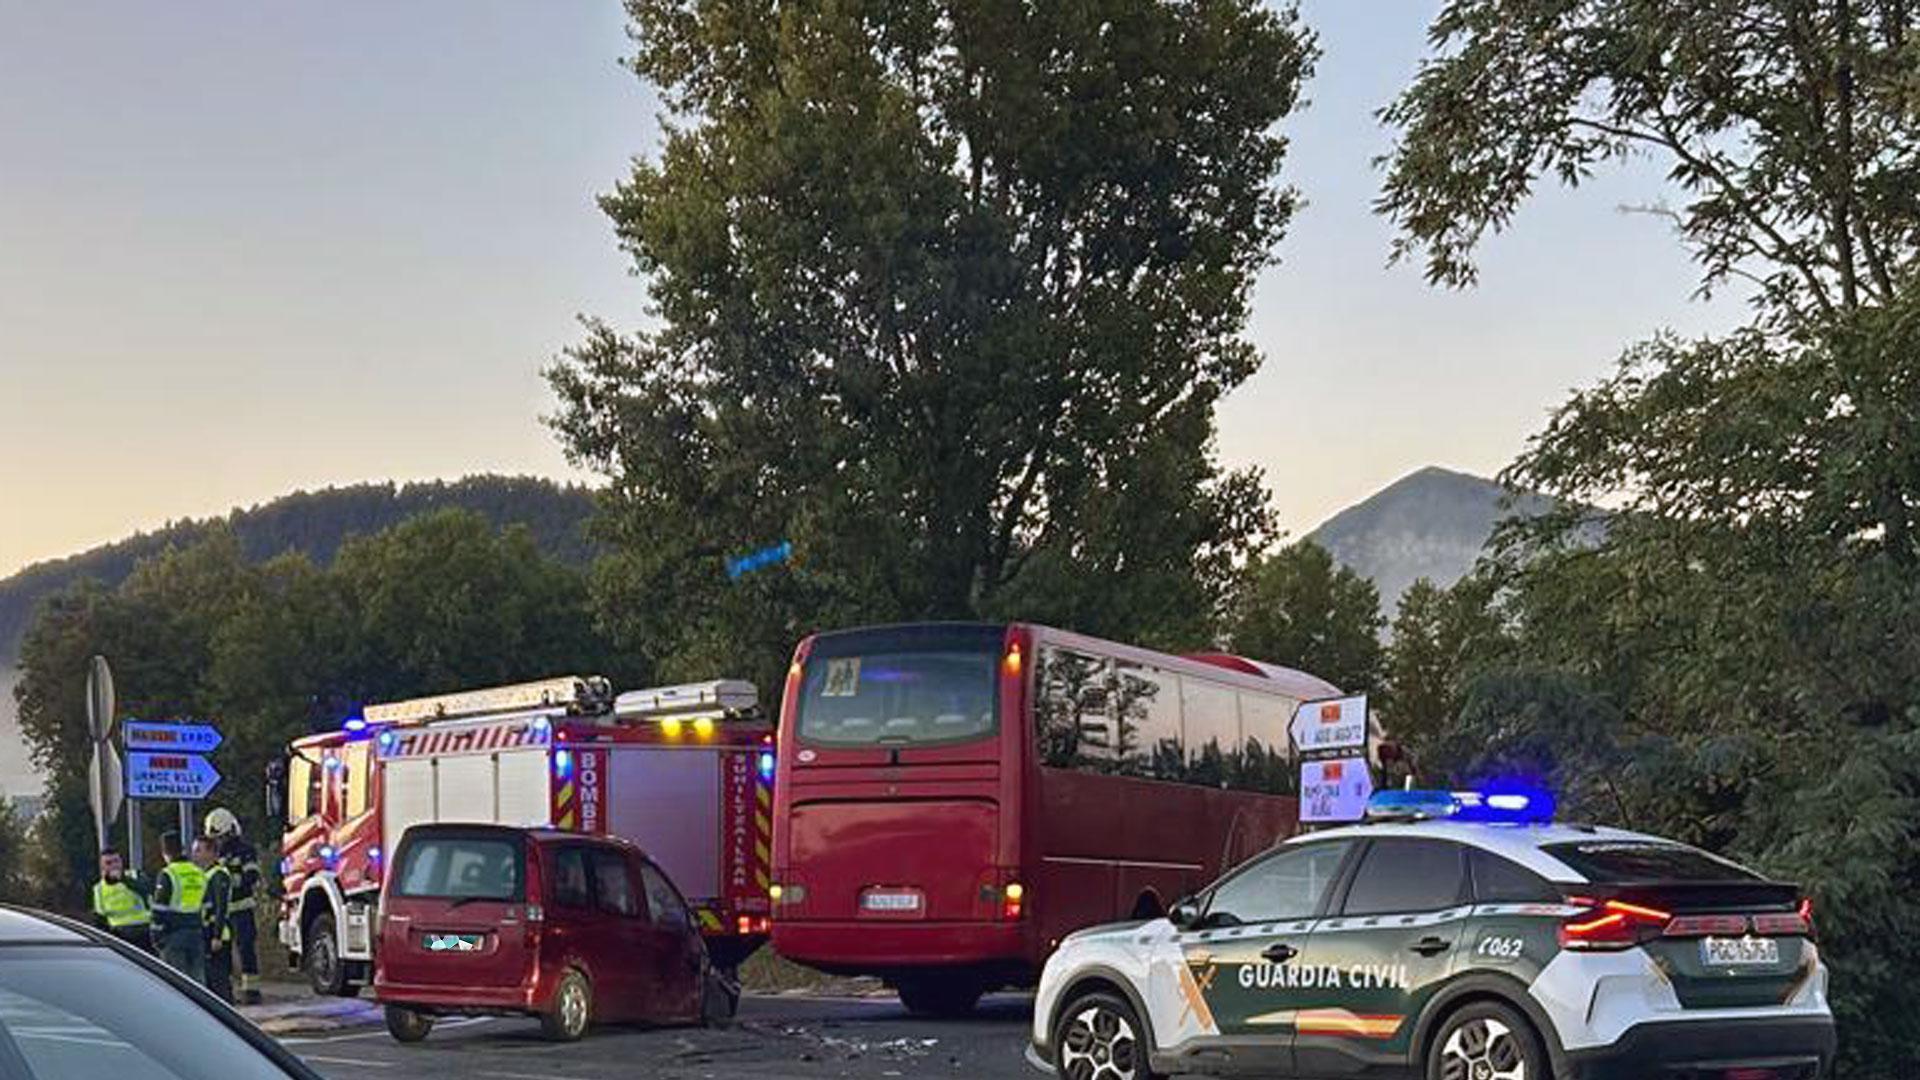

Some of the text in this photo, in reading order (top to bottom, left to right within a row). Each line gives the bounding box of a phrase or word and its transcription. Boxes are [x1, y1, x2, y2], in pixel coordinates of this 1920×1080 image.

[1489, 938, 1523, 957] 062
[1238, 963, 1410, 990] GUARDIA CIVIL
